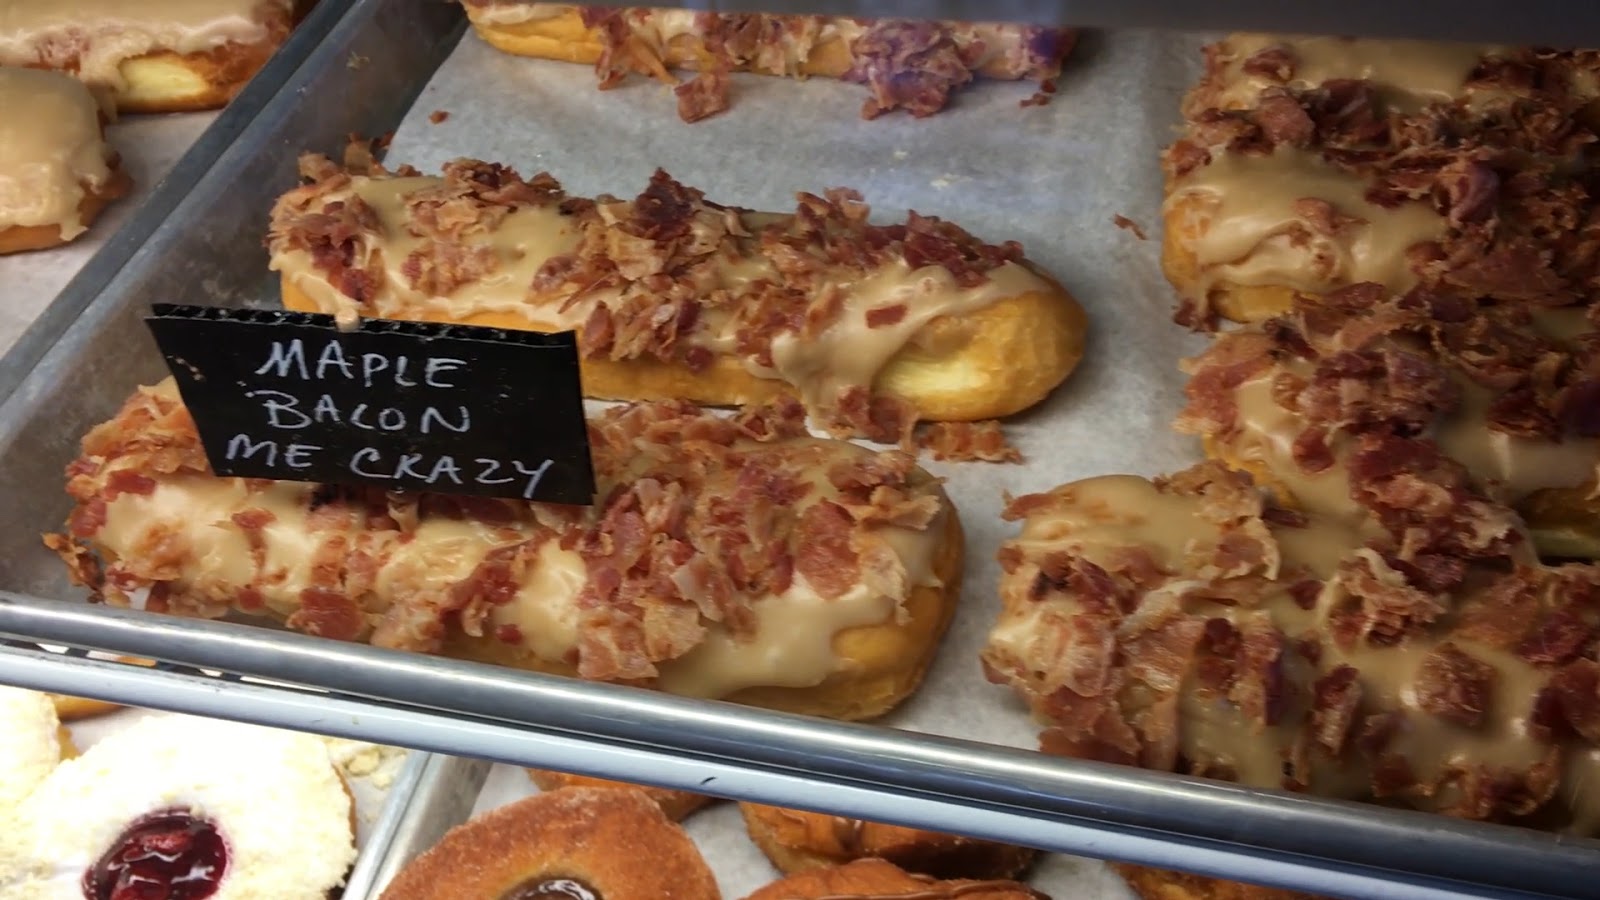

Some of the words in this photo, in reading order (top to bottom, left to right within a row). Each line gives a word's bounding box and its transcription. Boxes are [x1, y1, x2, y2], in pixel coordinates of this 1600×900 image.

[256, 339, 467, 387] MAPLE
[246, 390, 470, 434] BACON
[226, 433, 322, 468] ME
[349, 448, 555, 498] CRAZY
